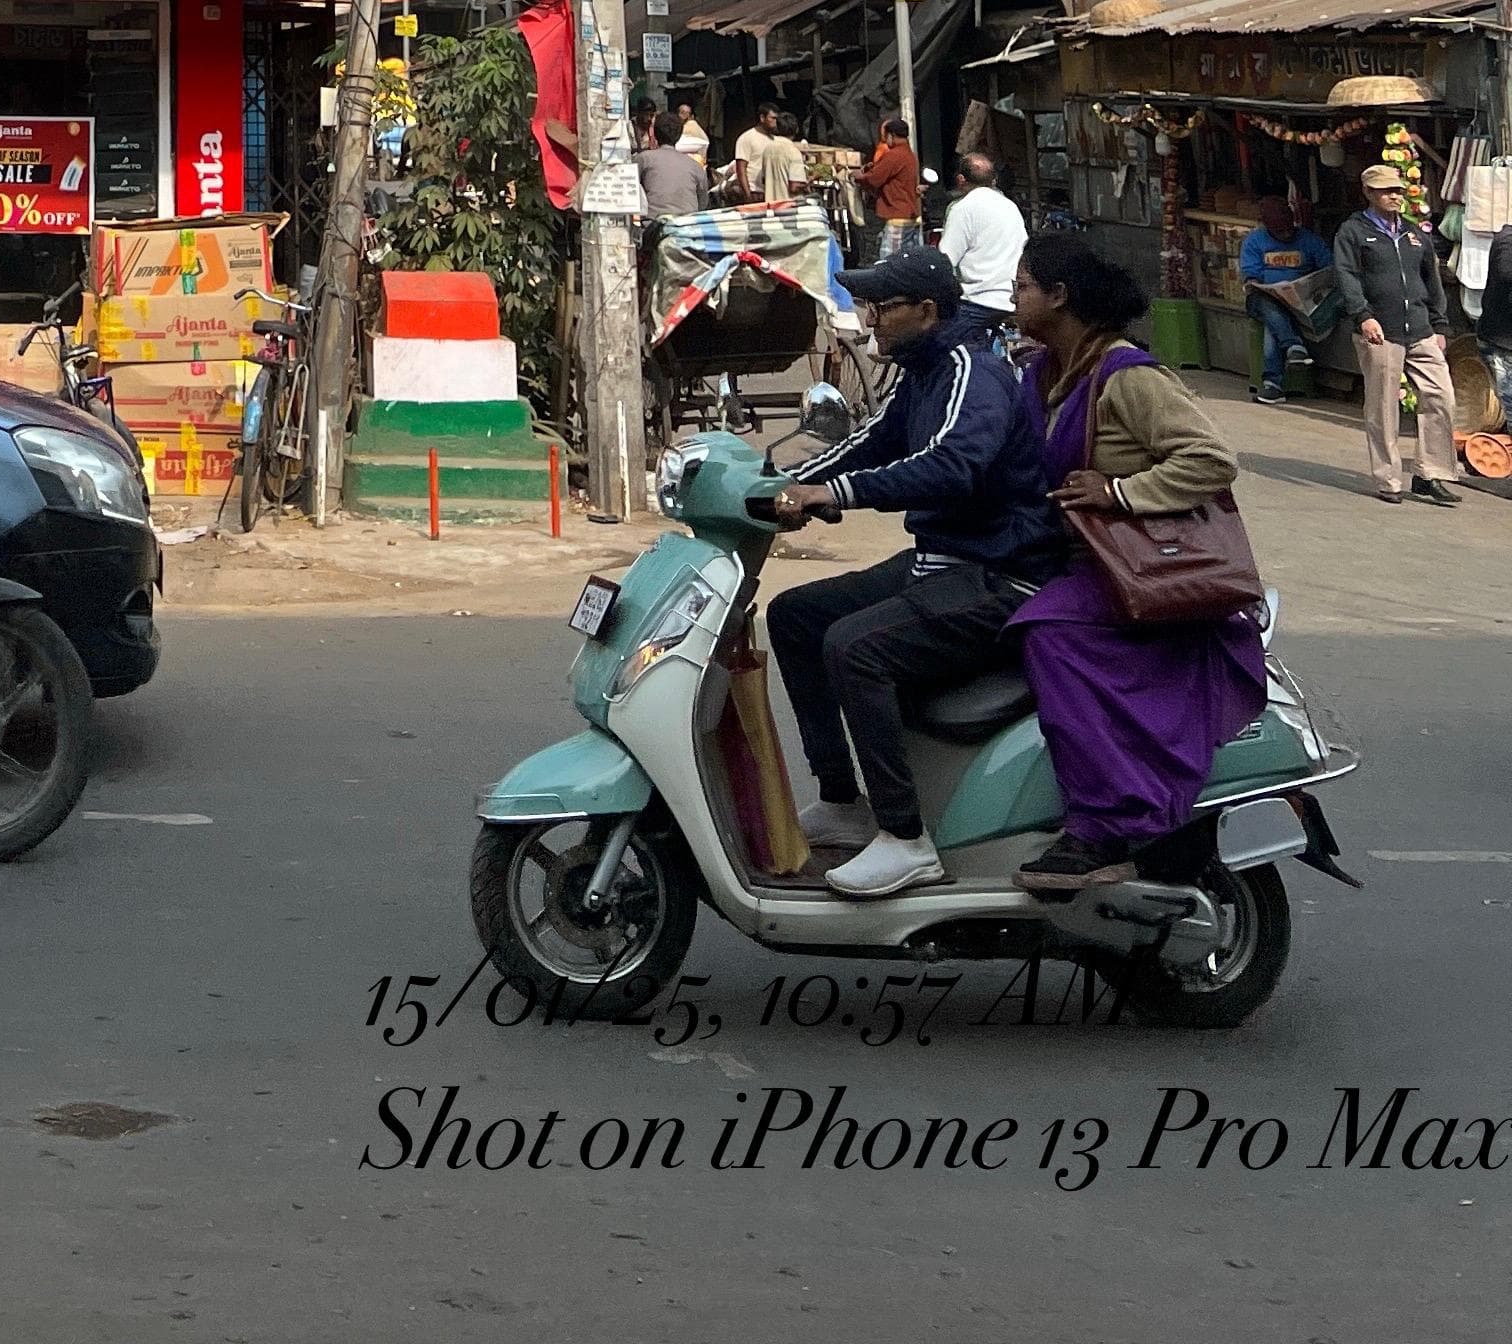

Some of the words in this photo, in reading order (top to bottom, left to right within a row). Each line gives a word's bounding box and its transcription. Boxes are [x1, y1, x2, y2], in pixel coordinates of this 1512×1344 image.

[9, 149, 40, 163] SEASON
[228, 246, 262, 259] Ajanta
[166, 315, 228, 338] Ajanta
